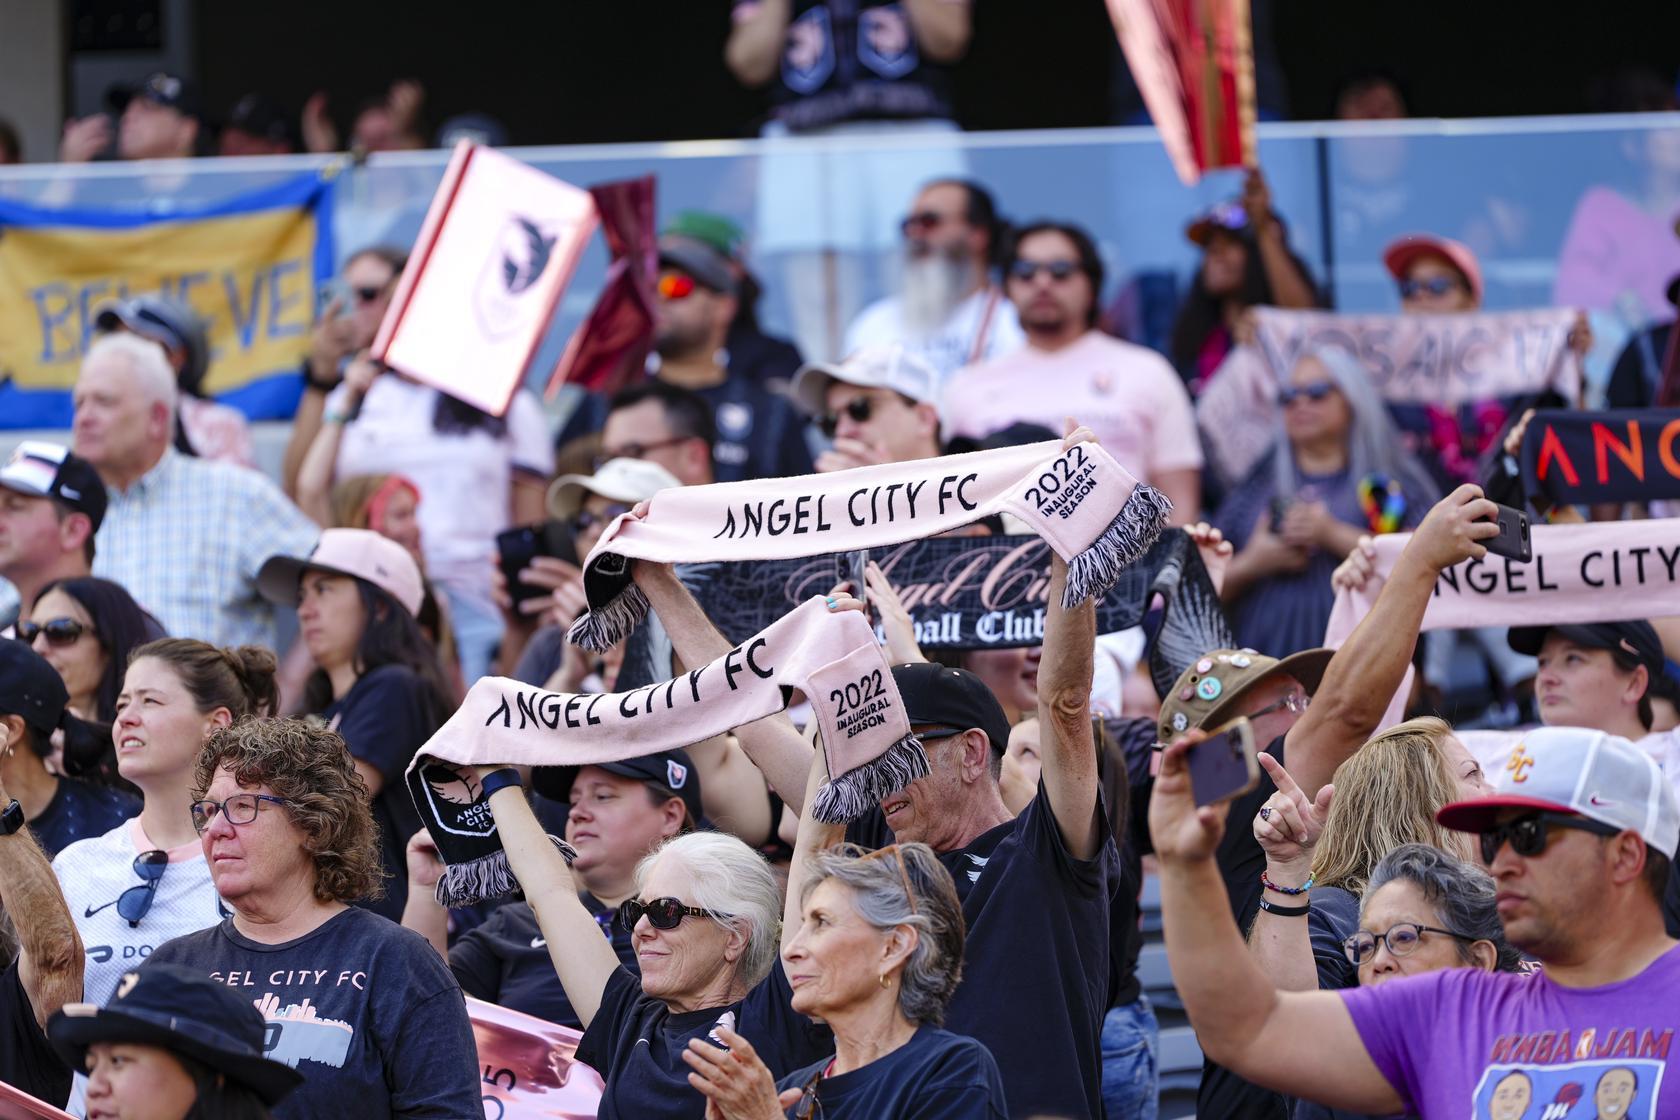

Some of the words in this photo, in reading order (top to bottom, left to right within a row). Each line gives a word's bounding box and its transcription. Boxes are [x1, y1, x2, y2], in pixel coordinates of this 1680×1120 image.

[27, 258, 306, 363] BEVE
[1025, 446, 1089, 510] 2022
[1041, 463, 1097, 518] INAUGURAL
[1058, 477, 1098, 520] SEASON
[713, 494, 831, 539] ANGEL
[848, 480, 928, 527] CITY
[938, 473, 979, 515] FC
[1580, 545, 1680, 588] CITY
[485, 691, 602, 730] ANGEL
[619, 664, 710, 718] CITY
[724, 637, 775, 691] FC
[830, 669, 886, 717] 2022
[837, 697, 891, 731] INAUGURAL
[847, 713, 886, 738] SEASON
[466, 811, 494, 827] CITY
[269, 969, 328, 986] CITY
[336, 970, 367, 991] FC
[1489, 1028, 1573, 1065] WNBA
[1594, 1026, 1674, 1060] JAM
